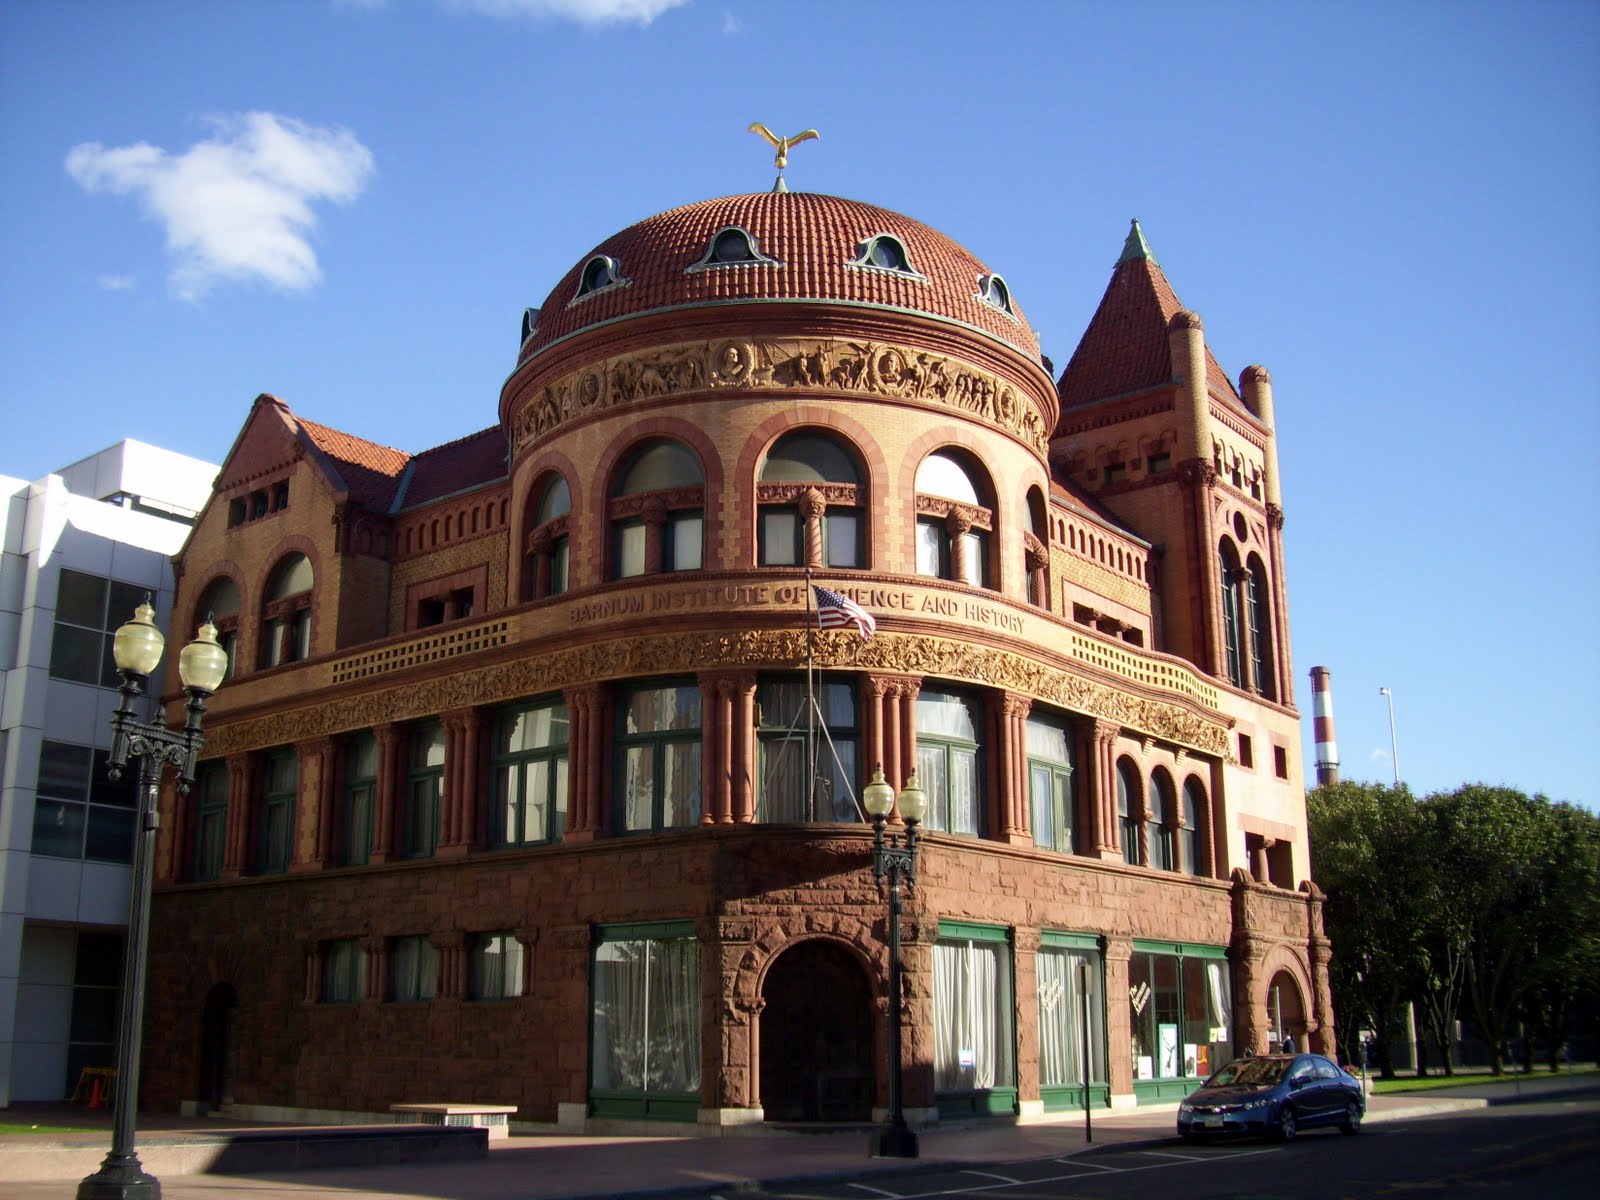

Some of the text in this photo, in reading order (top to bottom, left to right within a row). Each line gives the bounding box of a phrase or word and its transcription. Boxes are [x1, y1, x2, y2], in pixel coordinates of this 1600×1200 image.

[569, 585, 1025, 634] BARNUM INSTITUTE OF CIENCE AND HISTORY
